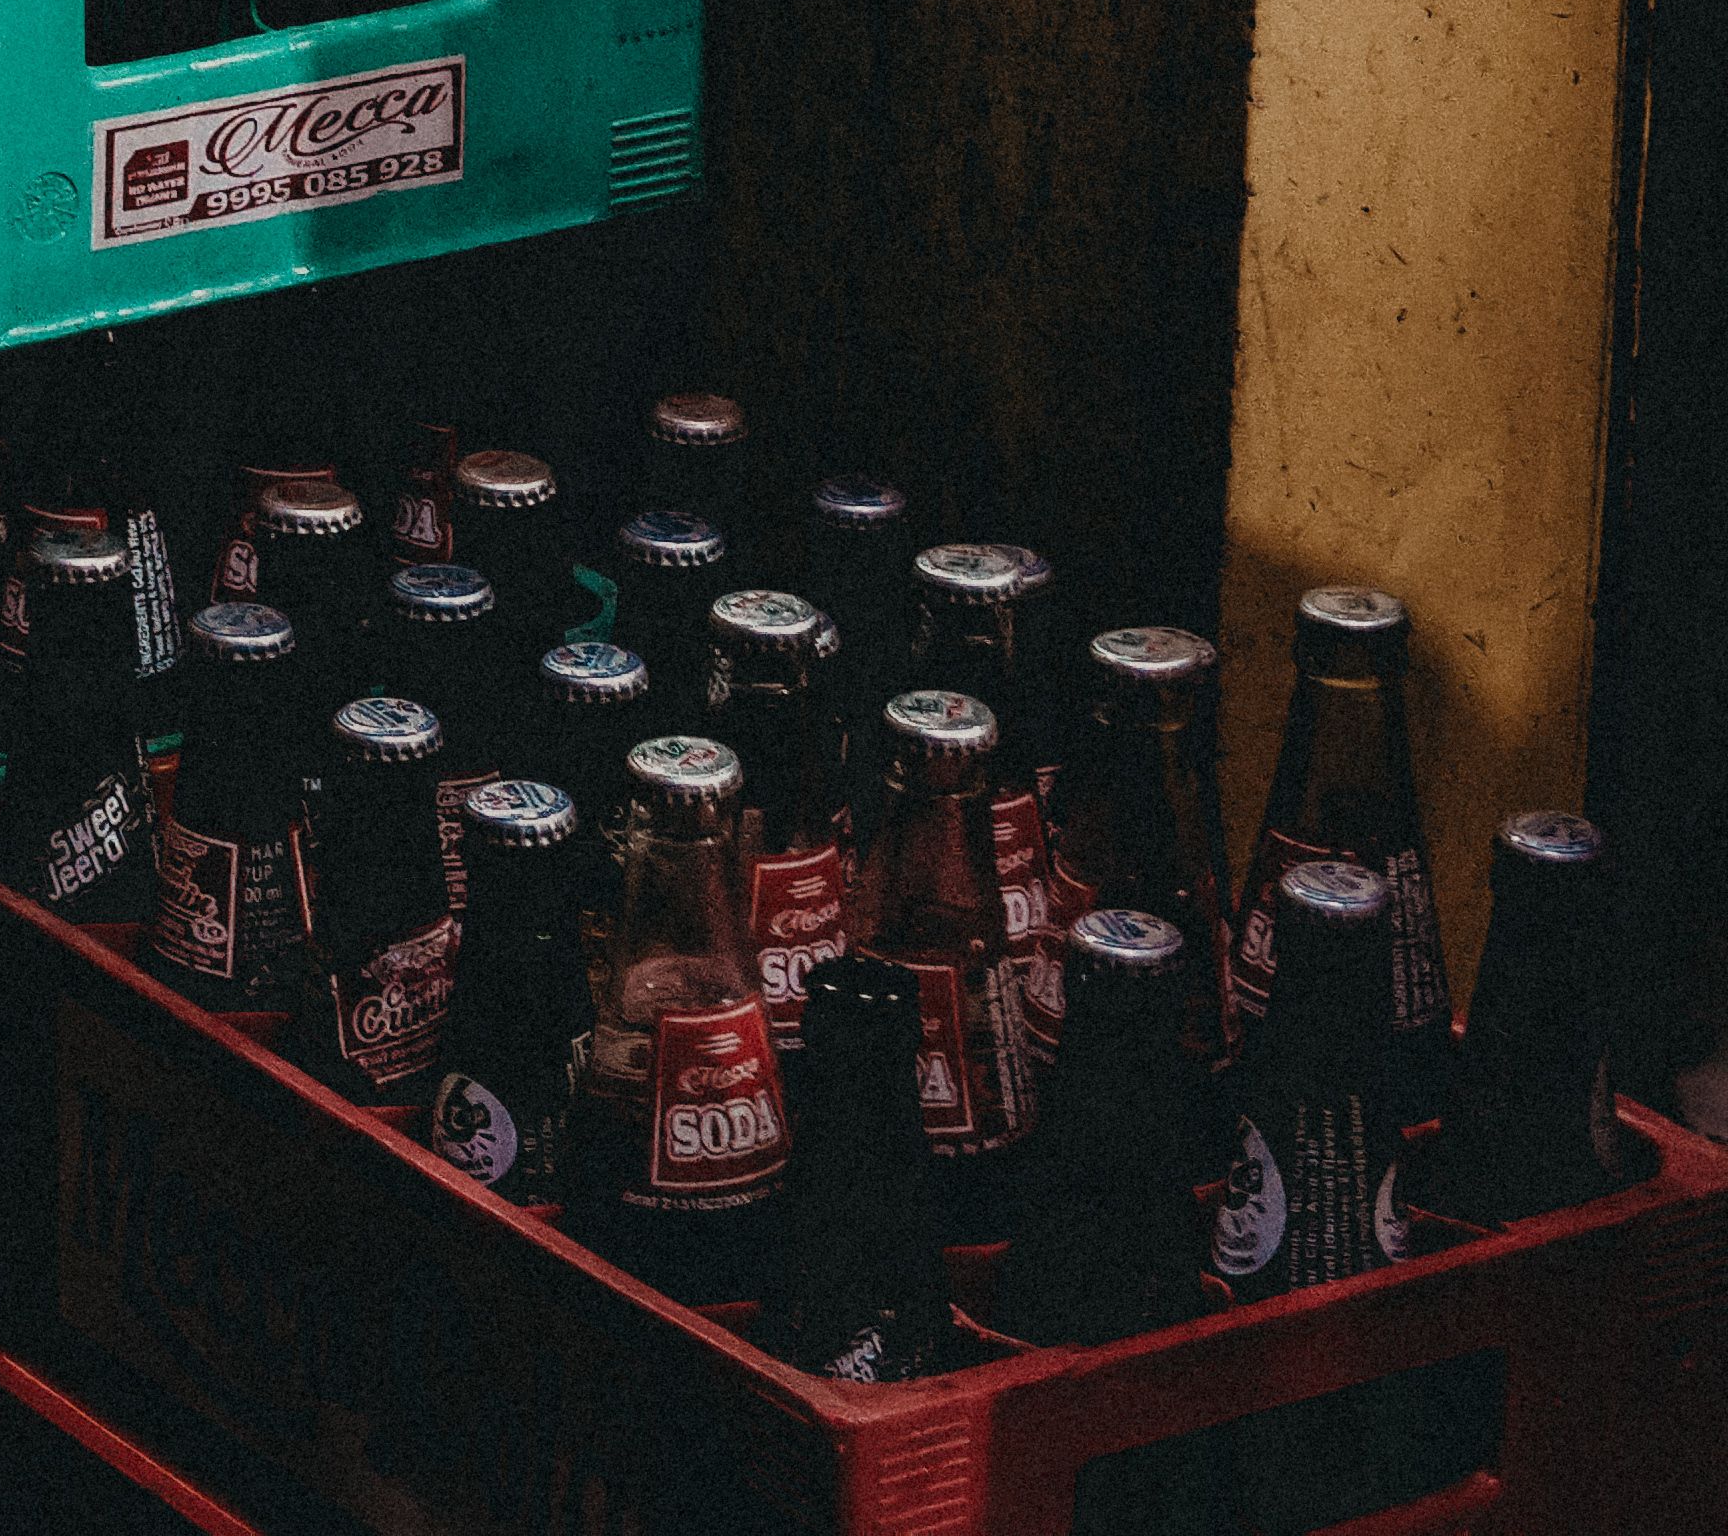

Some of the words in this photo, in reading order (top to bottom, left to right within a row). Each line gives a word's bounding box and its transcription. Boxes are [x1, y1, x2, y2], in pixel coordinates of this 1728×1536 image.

[199, 81, 450, 178] Mecca
[205, 176, 293, 218] 9995
[303, 166, 370, 200] 085
[378, 150, 444, 181] 928
[49, 780, 131, 866] Sweet
[47, 831, 125, 903] Jeera
[665, 1088, 780, 1164] SODA
